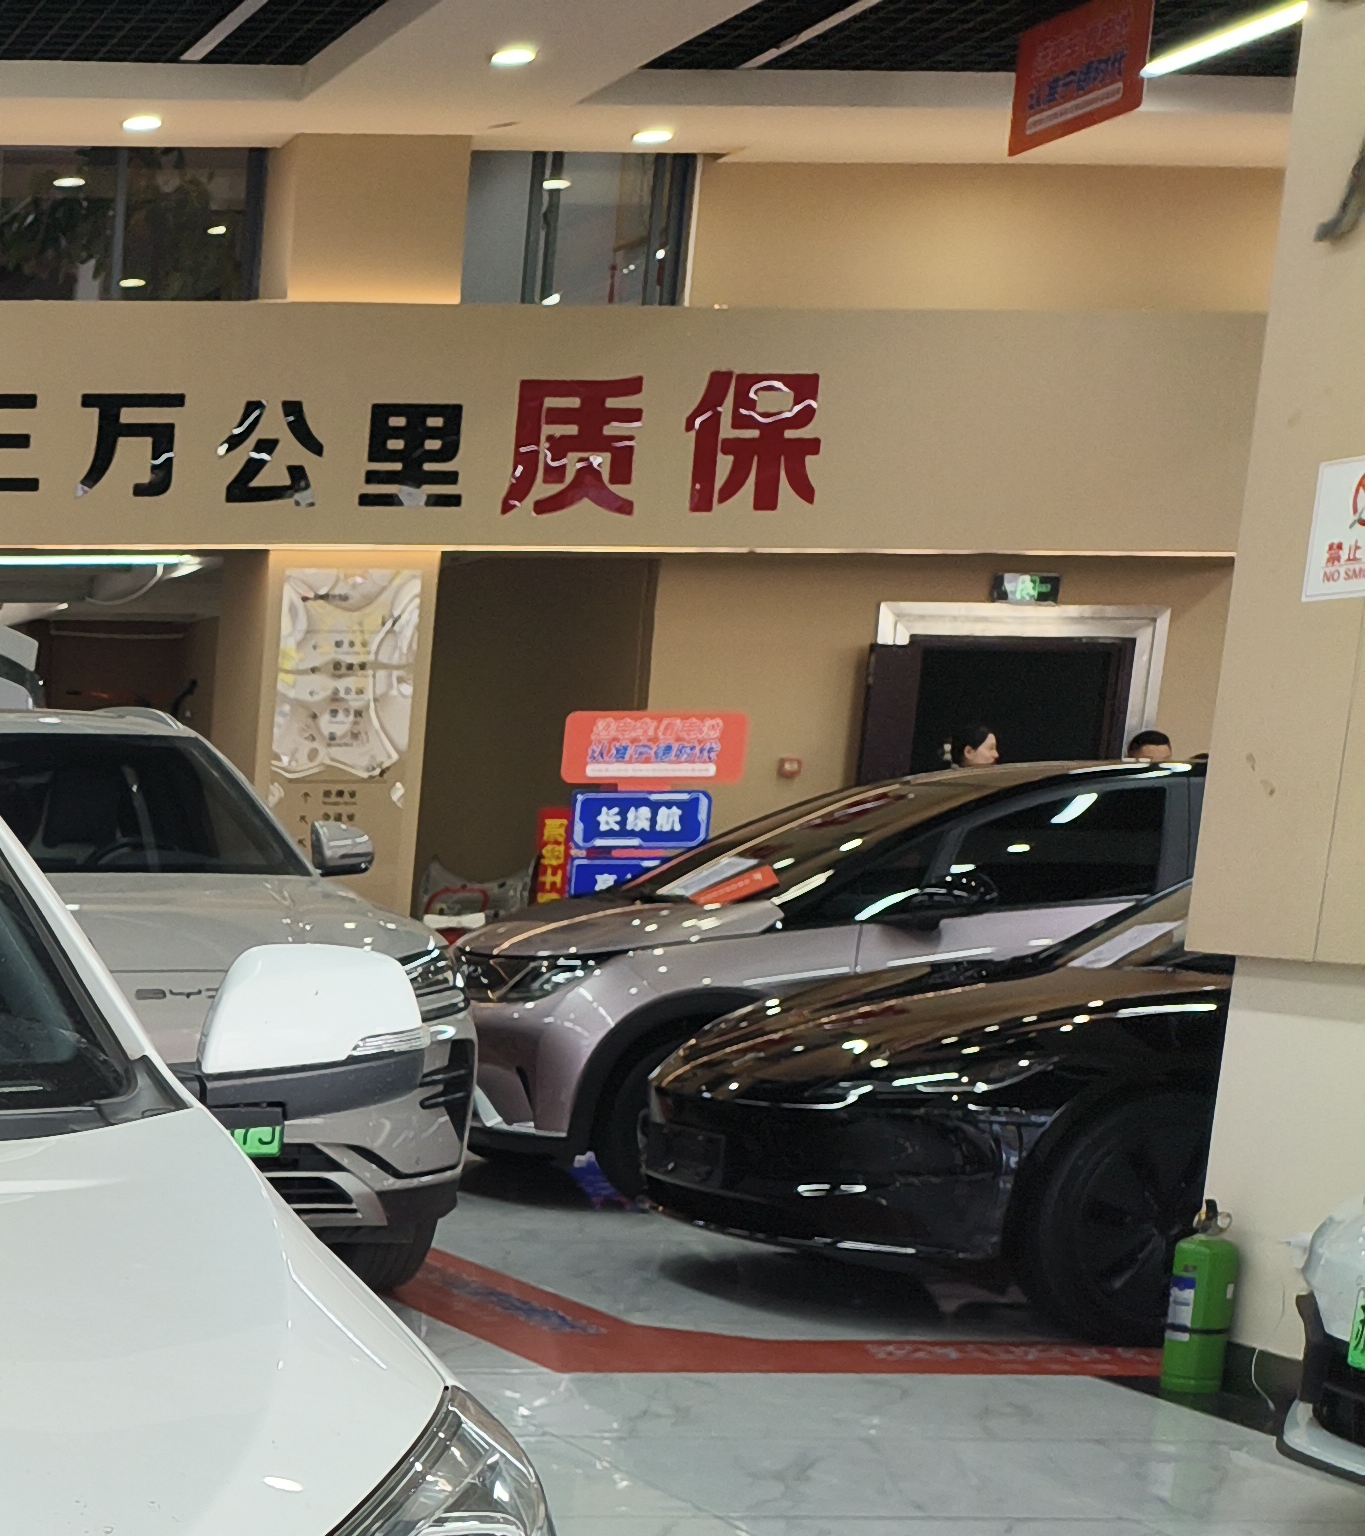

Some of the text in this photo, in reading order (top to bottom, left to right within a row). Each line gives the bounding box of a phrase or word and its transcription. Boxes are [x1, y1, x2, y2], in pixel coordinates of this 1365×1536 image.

[1322, 569, 1341, 584] NO
[596, 805, 682, 832] 长续航
